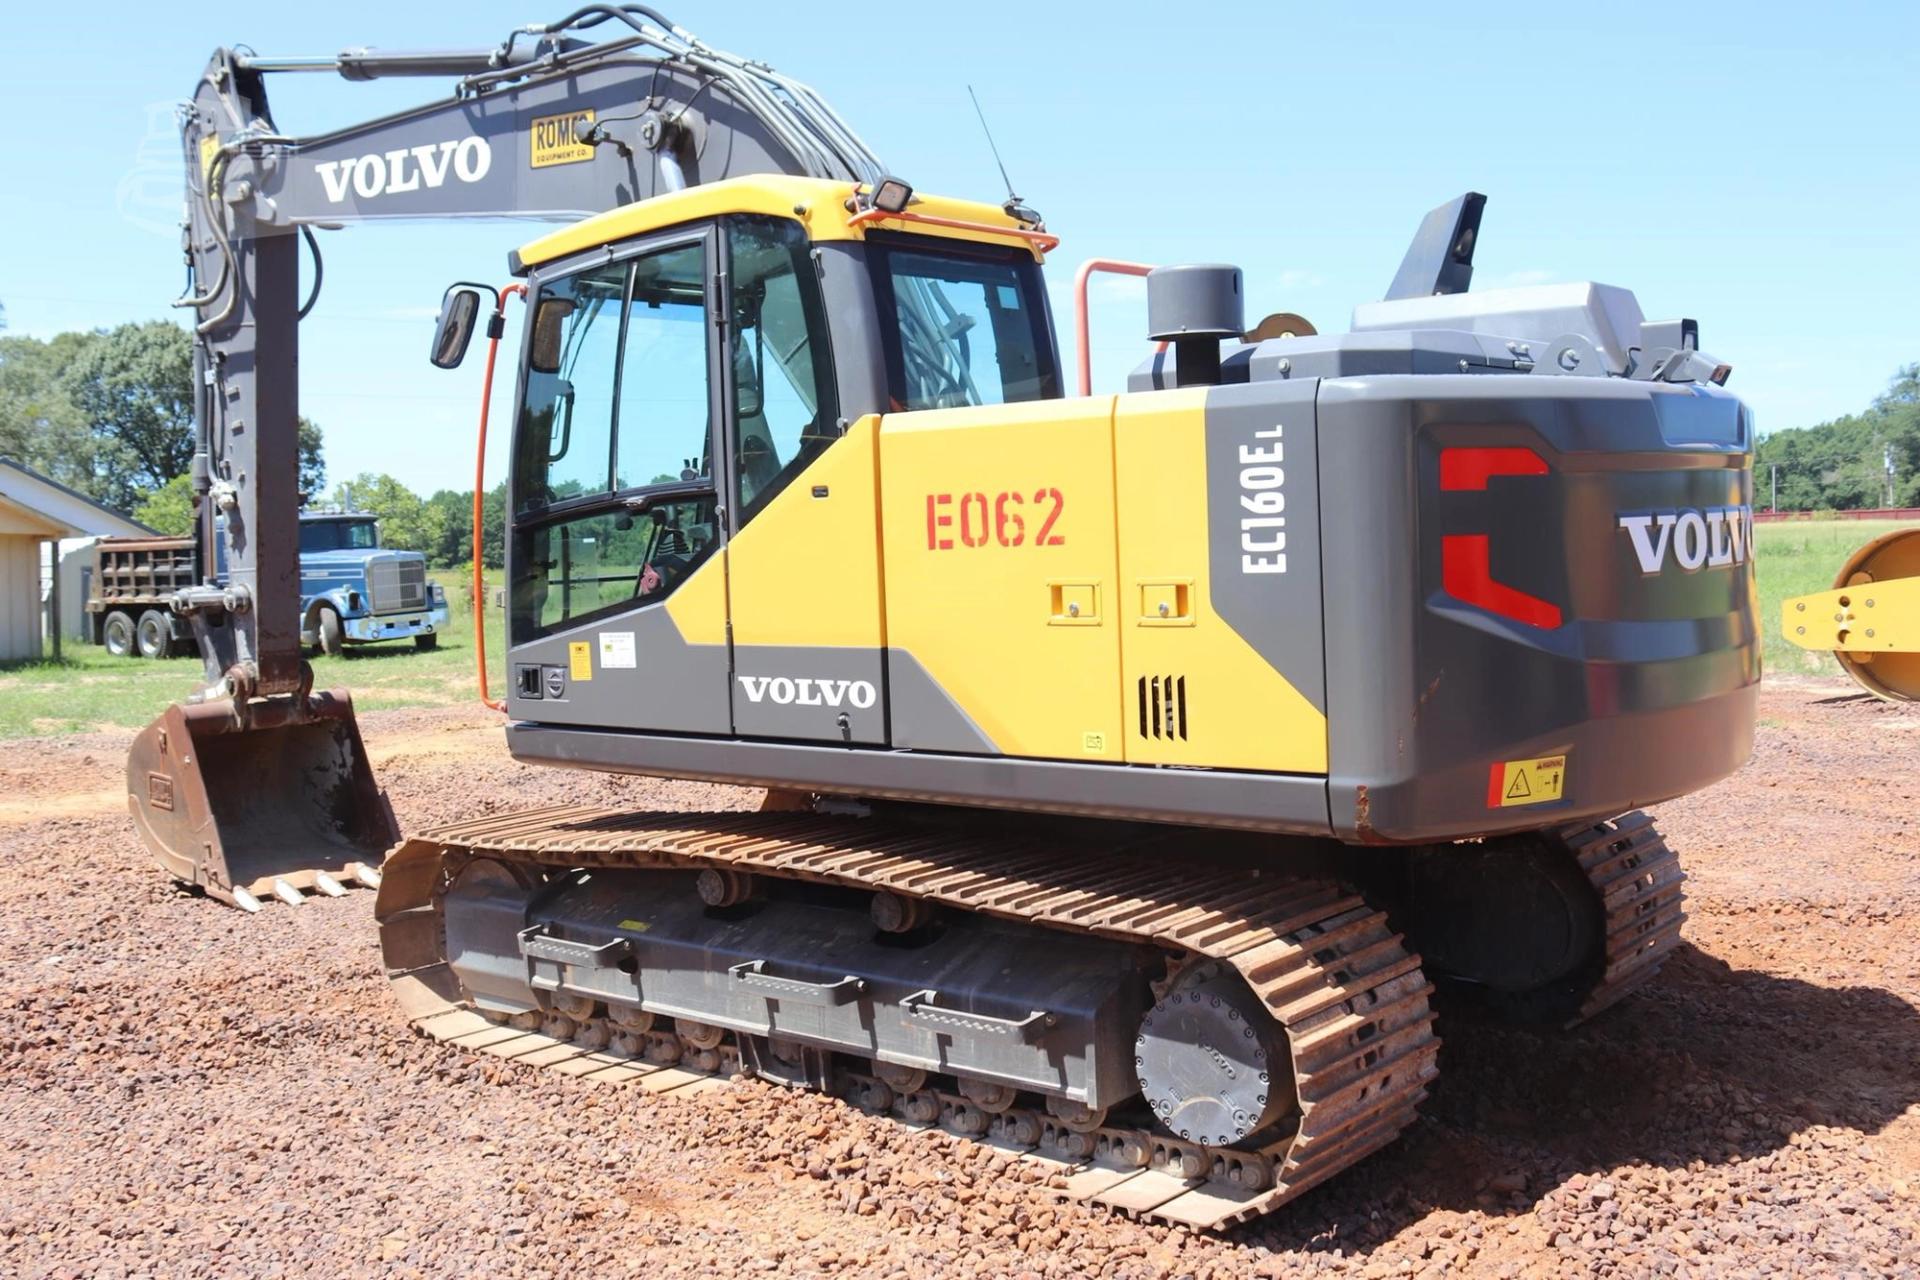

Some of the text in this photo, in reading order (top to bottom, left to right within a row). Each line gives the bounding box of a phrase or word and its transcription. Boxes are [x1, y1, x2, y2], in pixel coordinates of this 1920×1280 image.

[537, 114, 588, 150] ROMC
[315, 136, 491, 203] VOLVO
[926, 487, 1065, 551] E062
[738, 676, 876, 709] VOLVO
